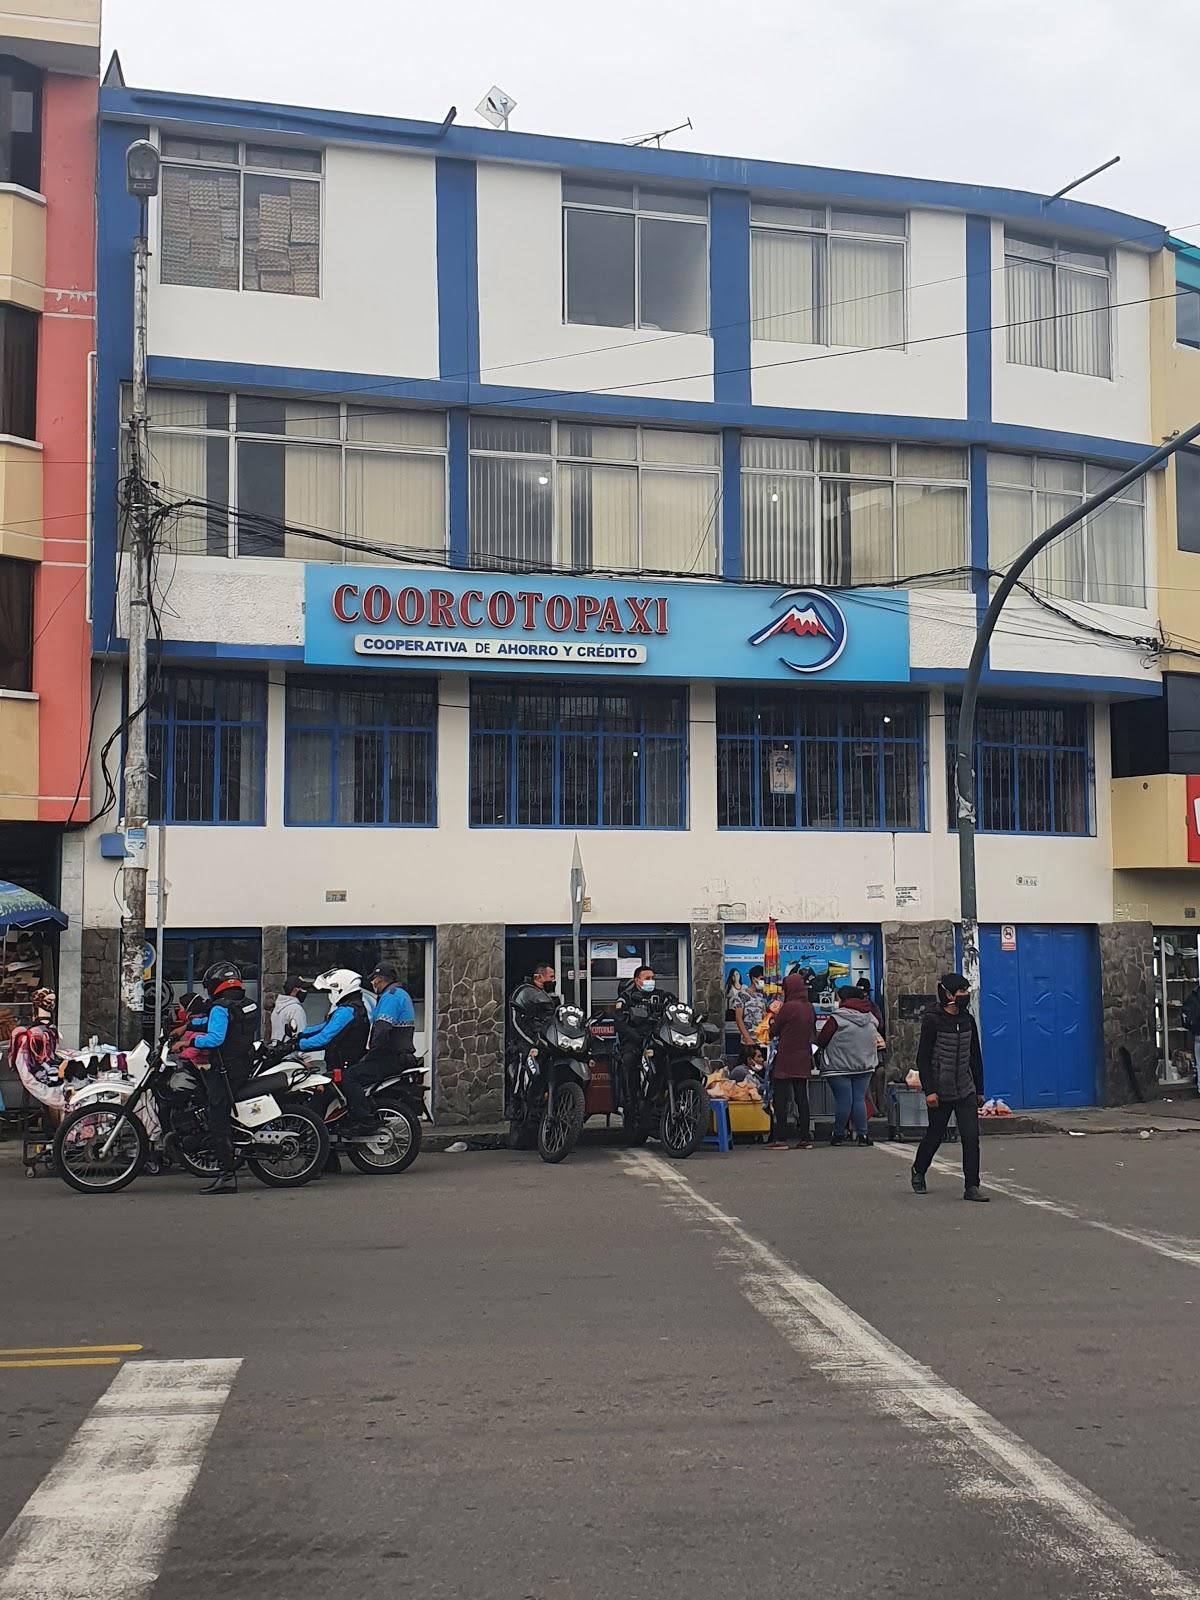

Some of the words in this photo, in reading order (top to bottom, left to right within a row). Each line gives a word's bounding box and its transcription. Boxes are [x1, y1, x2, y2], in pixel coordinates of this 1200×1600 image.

[333, 583, 669, 634] COORCOTOPAXI
[363, 638, 468, 653] COOPERATIVA
[475, 642, 490, 654] DE
[497, 643, 558, 656] AHORRO
[563, 645, 573, 657] Y
[577, 644, 637, 659] CRÉDITO
